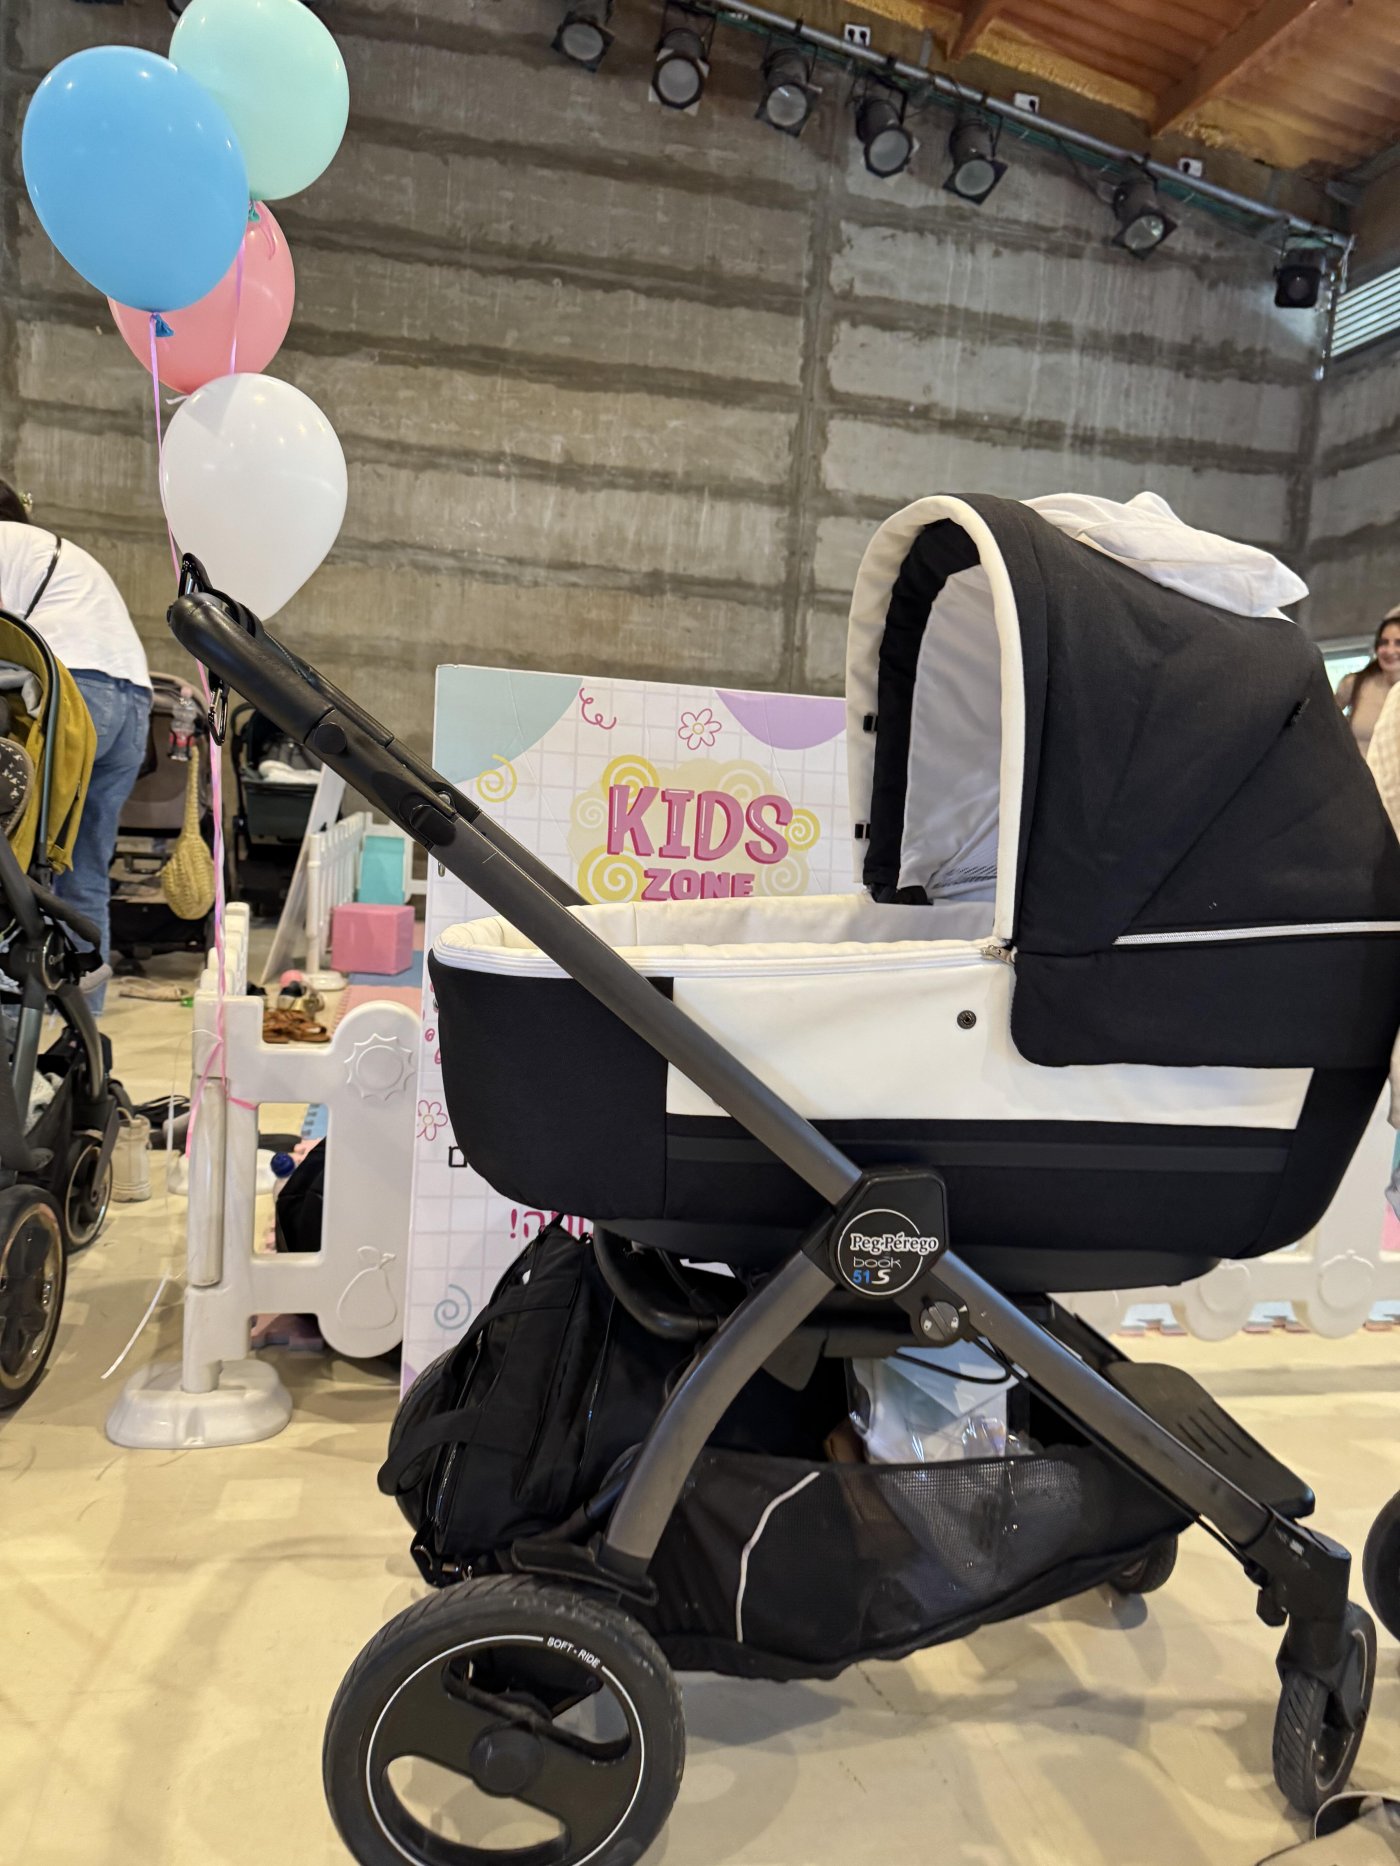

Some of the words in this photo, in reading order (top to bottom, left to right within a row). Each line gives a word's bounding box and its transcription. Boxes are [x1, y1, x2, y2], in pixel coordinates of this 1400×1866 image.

[607, 784, 794, 865] KIDS
[641, 867, 756, 901] ZONE
[853, 1256, 902, 1269] book
